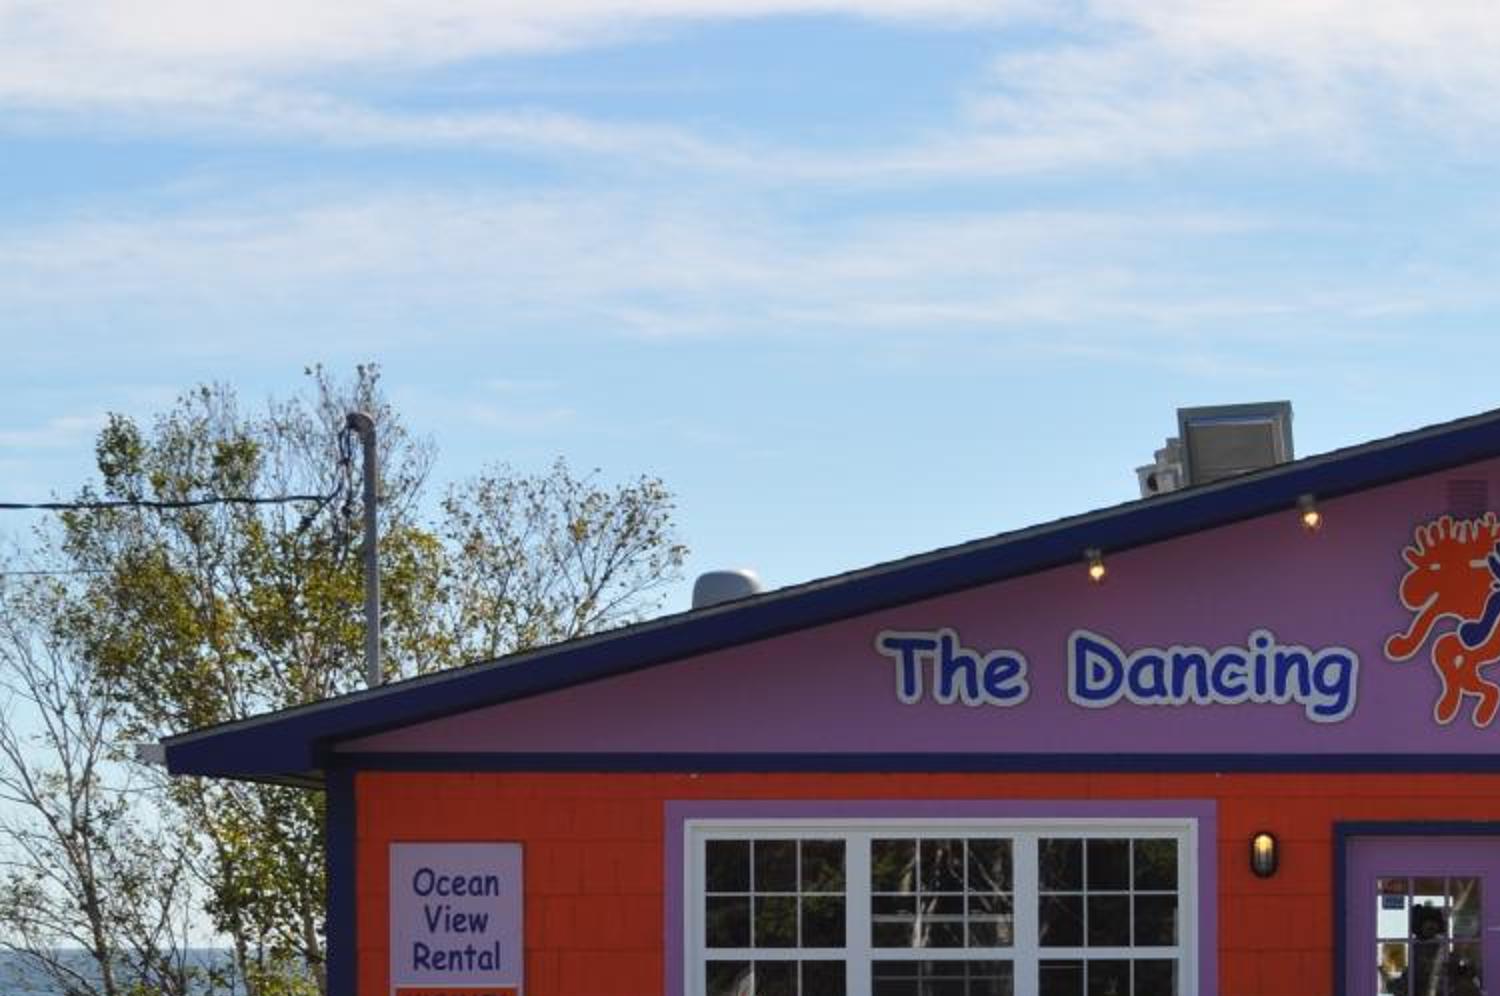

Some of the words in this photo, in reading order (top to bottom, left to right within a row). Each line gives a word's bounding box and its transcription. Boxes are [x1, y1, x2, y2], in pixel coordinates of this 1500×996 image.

[877, 630, 1029, 705] The
[1068, 630, 1359, 723] Dancing
[412, 867, 500, 896] Ocean
[424, 904, 489, 934] View
[412, 941, 501, 971] Rental
